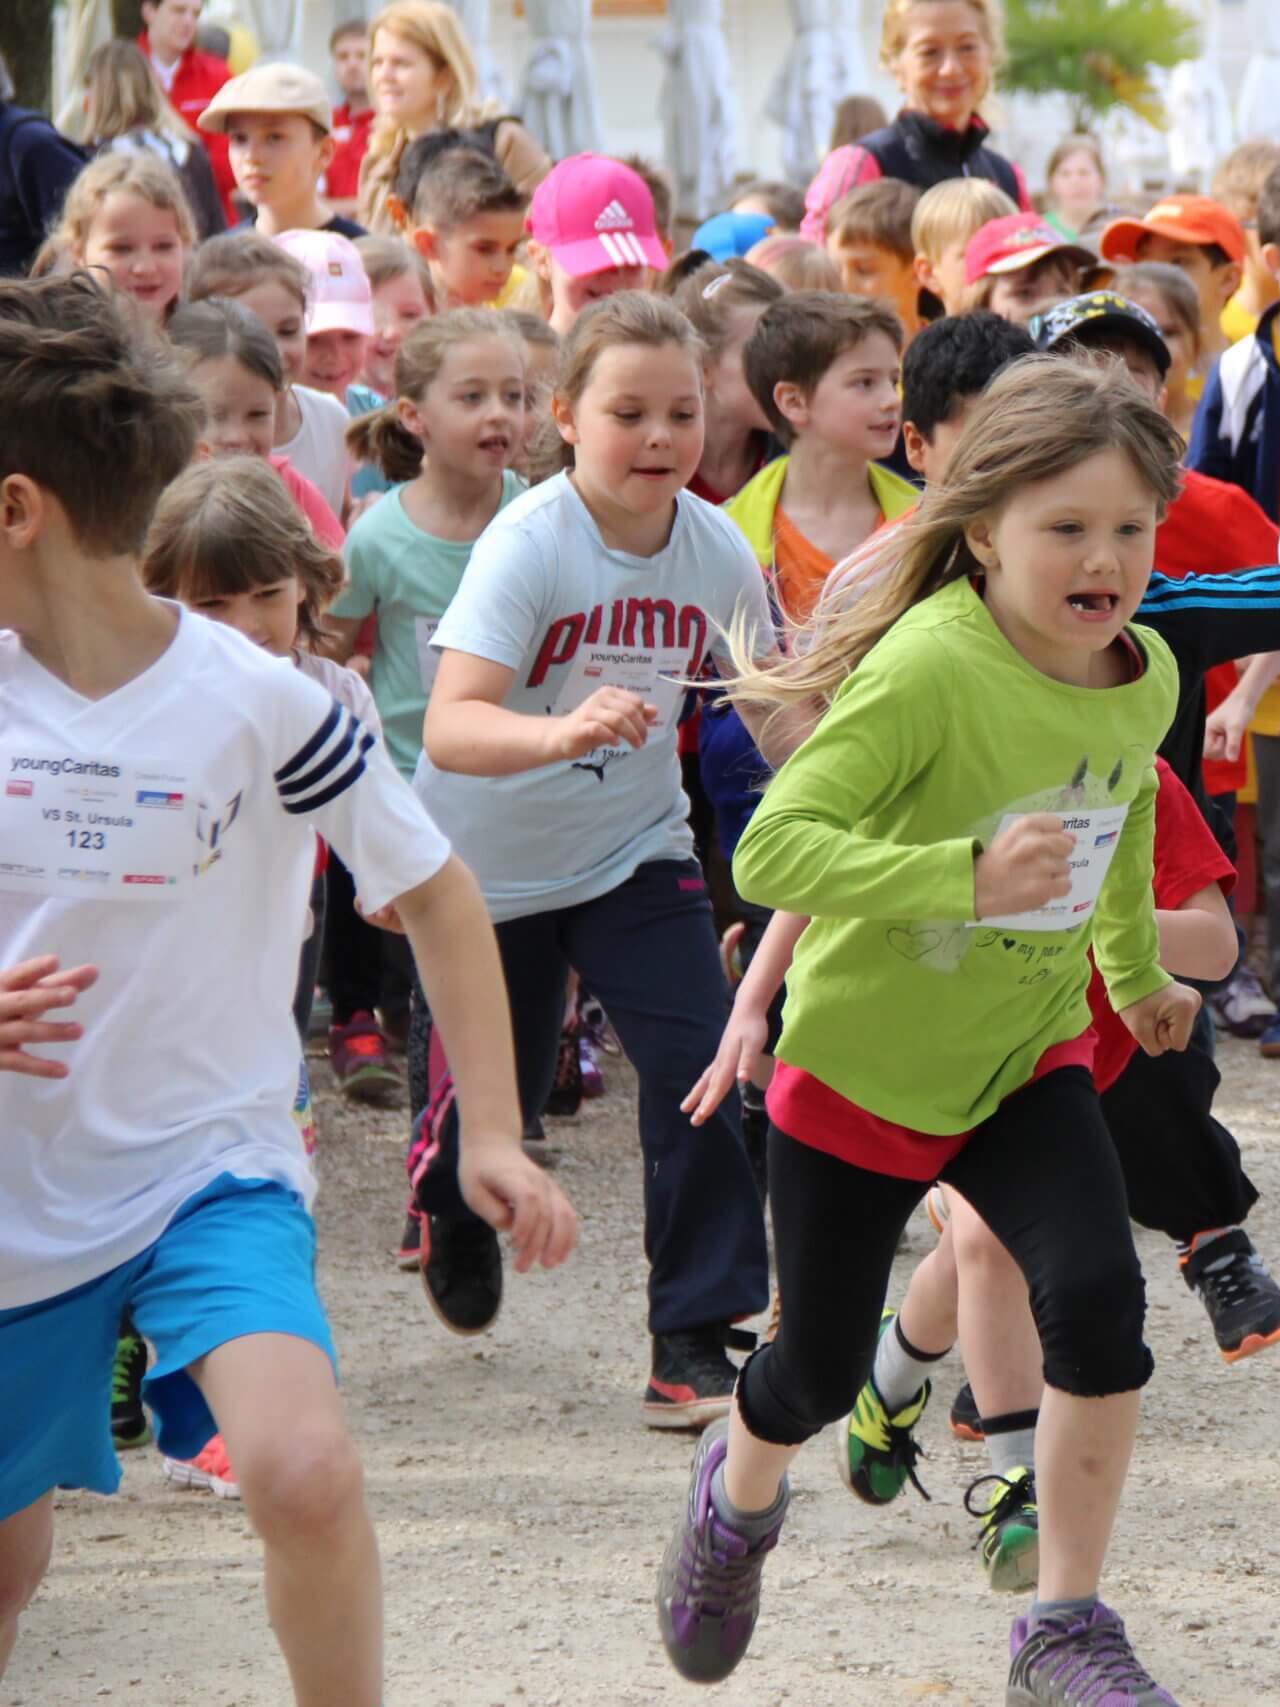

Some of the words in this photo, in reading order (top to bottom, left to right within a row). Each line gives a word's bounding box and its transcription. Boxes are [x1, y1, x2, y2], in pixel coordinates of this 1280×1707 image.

[590, 652, 653, 665] youngCaritas
[10, 756, 121, 777] youngCaritas
[42, 808, 61, 821] VS
[66, 810, 83, 823] St.
[88, 813, 133, 828] Ursula
[66, 829, 106, 851] 123
[1069, 857, 1090, 869] rsula
